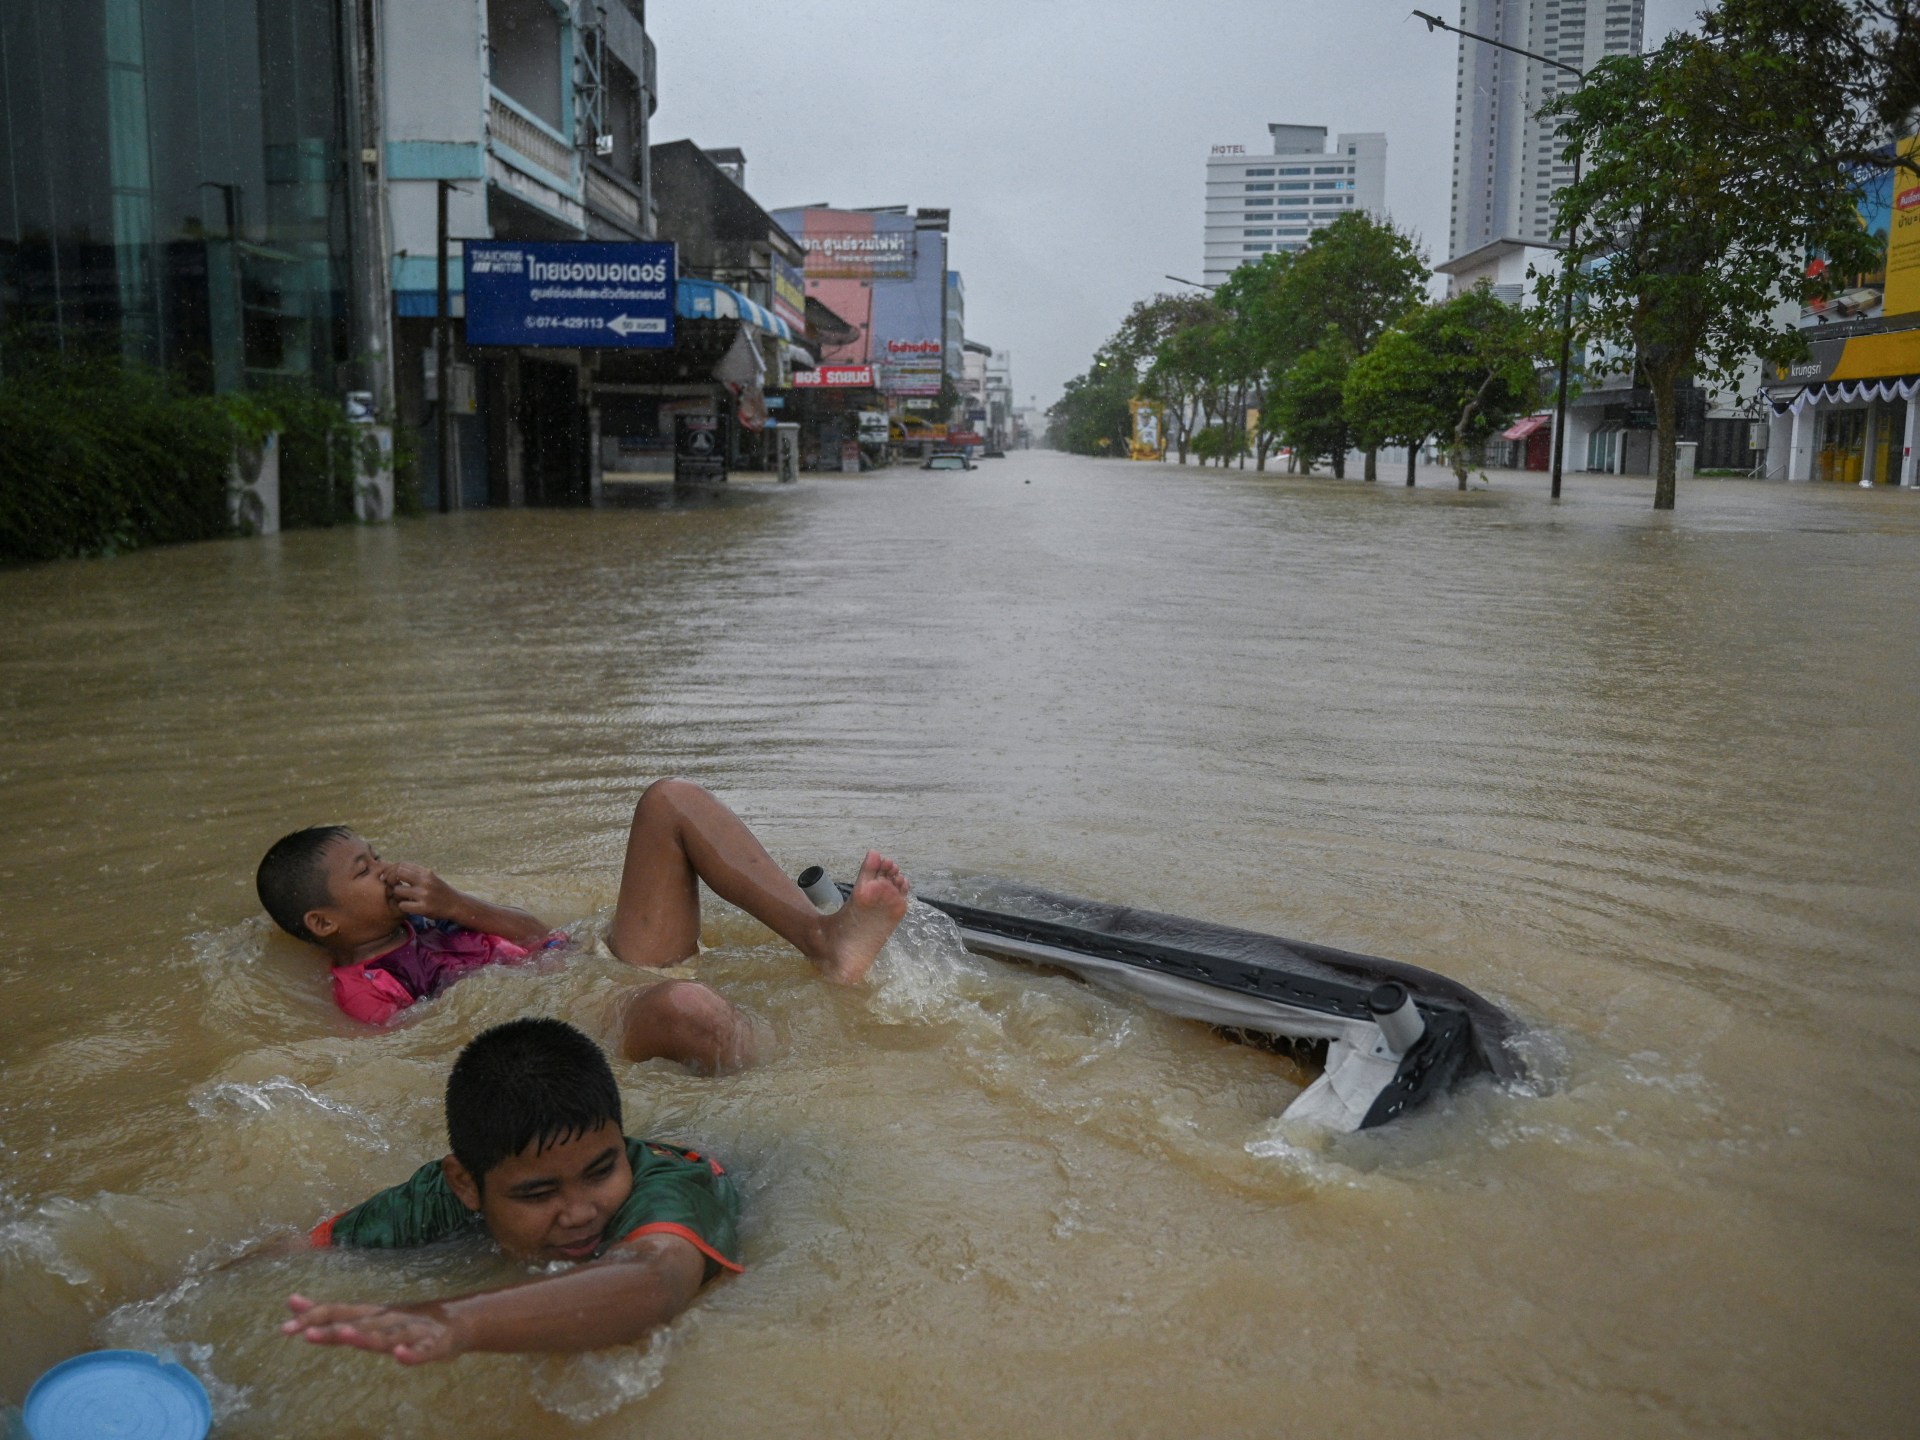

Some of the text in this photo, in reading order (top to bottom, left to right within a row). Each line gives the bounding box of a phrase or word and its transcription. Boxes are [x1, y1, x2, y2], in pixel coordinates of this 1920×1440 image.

[1211, 145, 1245, 154] HOTEL
[795, 367, 821, 384] แอร์
[826, 366, 870, 384] รถยนต์
[1791, 361, 1822, 378] krungsri
